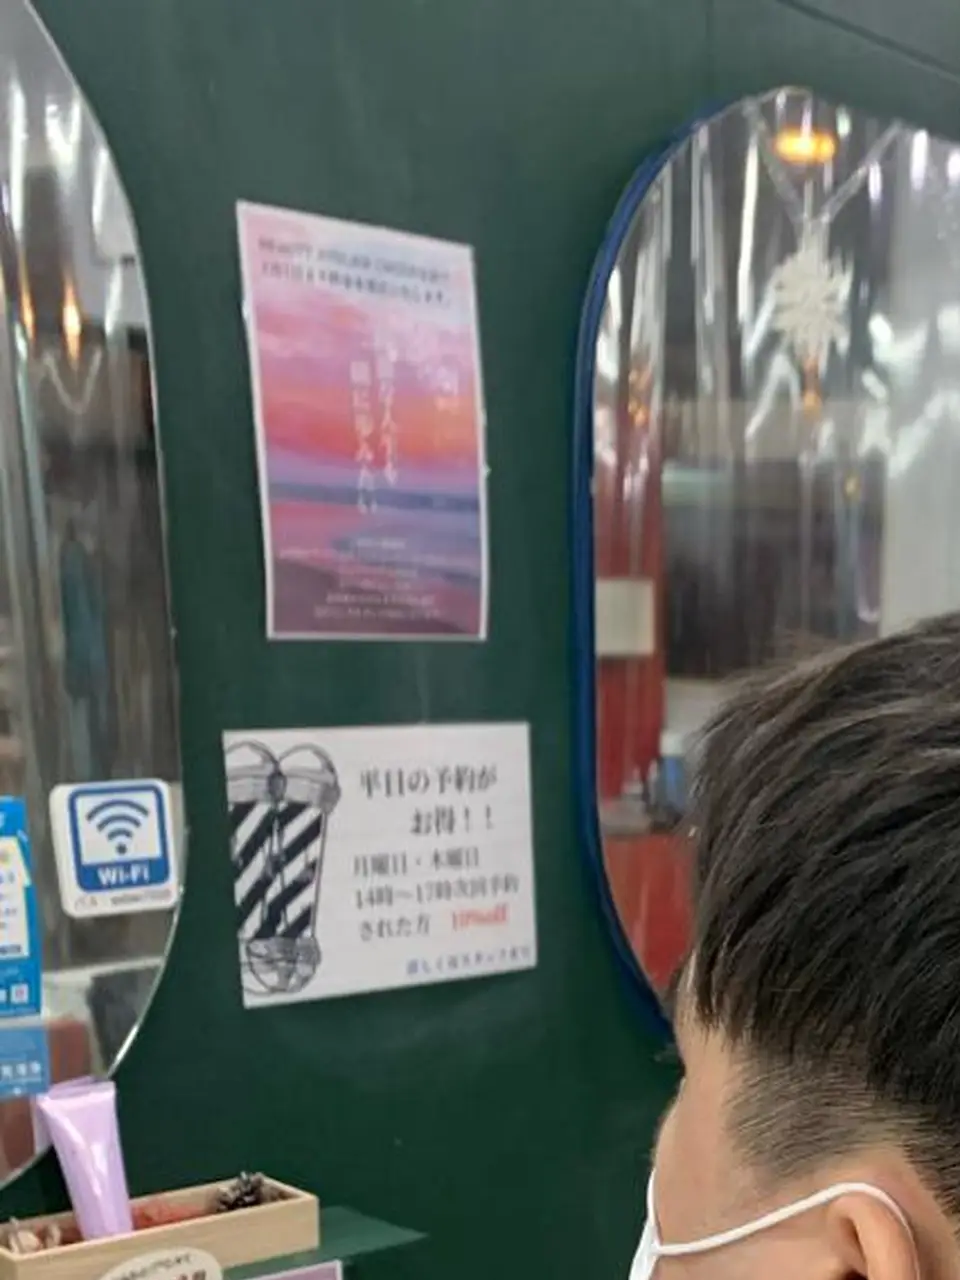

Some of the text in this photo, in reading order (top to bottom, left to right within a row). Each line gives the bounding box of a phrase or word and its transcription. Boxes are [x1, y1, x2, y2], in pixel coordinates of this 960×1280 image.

[360, 764, 498, 800] 平日の予約が
[97, 863, 150, 887] Wi-Fi
